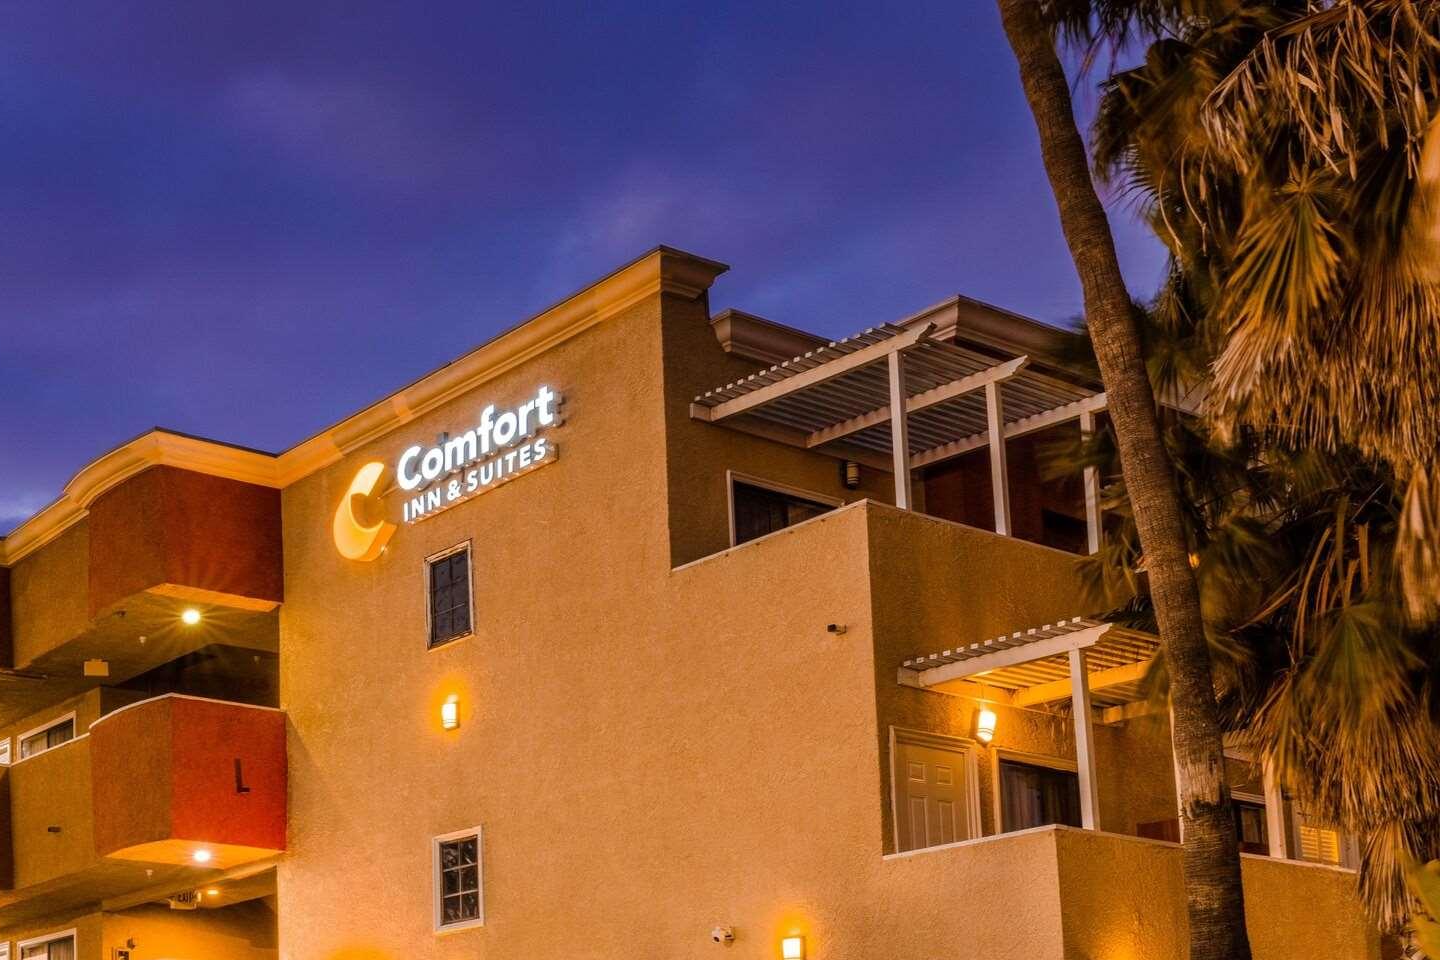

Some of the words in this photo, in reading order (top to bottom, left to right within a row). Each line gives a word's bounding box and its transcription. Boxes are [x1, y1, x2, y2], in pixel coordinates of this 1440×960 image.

[397, 385, 555, 490] Comfort
[403, 479, 442, 522] INN
[447, 479, 462, 501] &
[467, 438, 546, 491] SUITES
